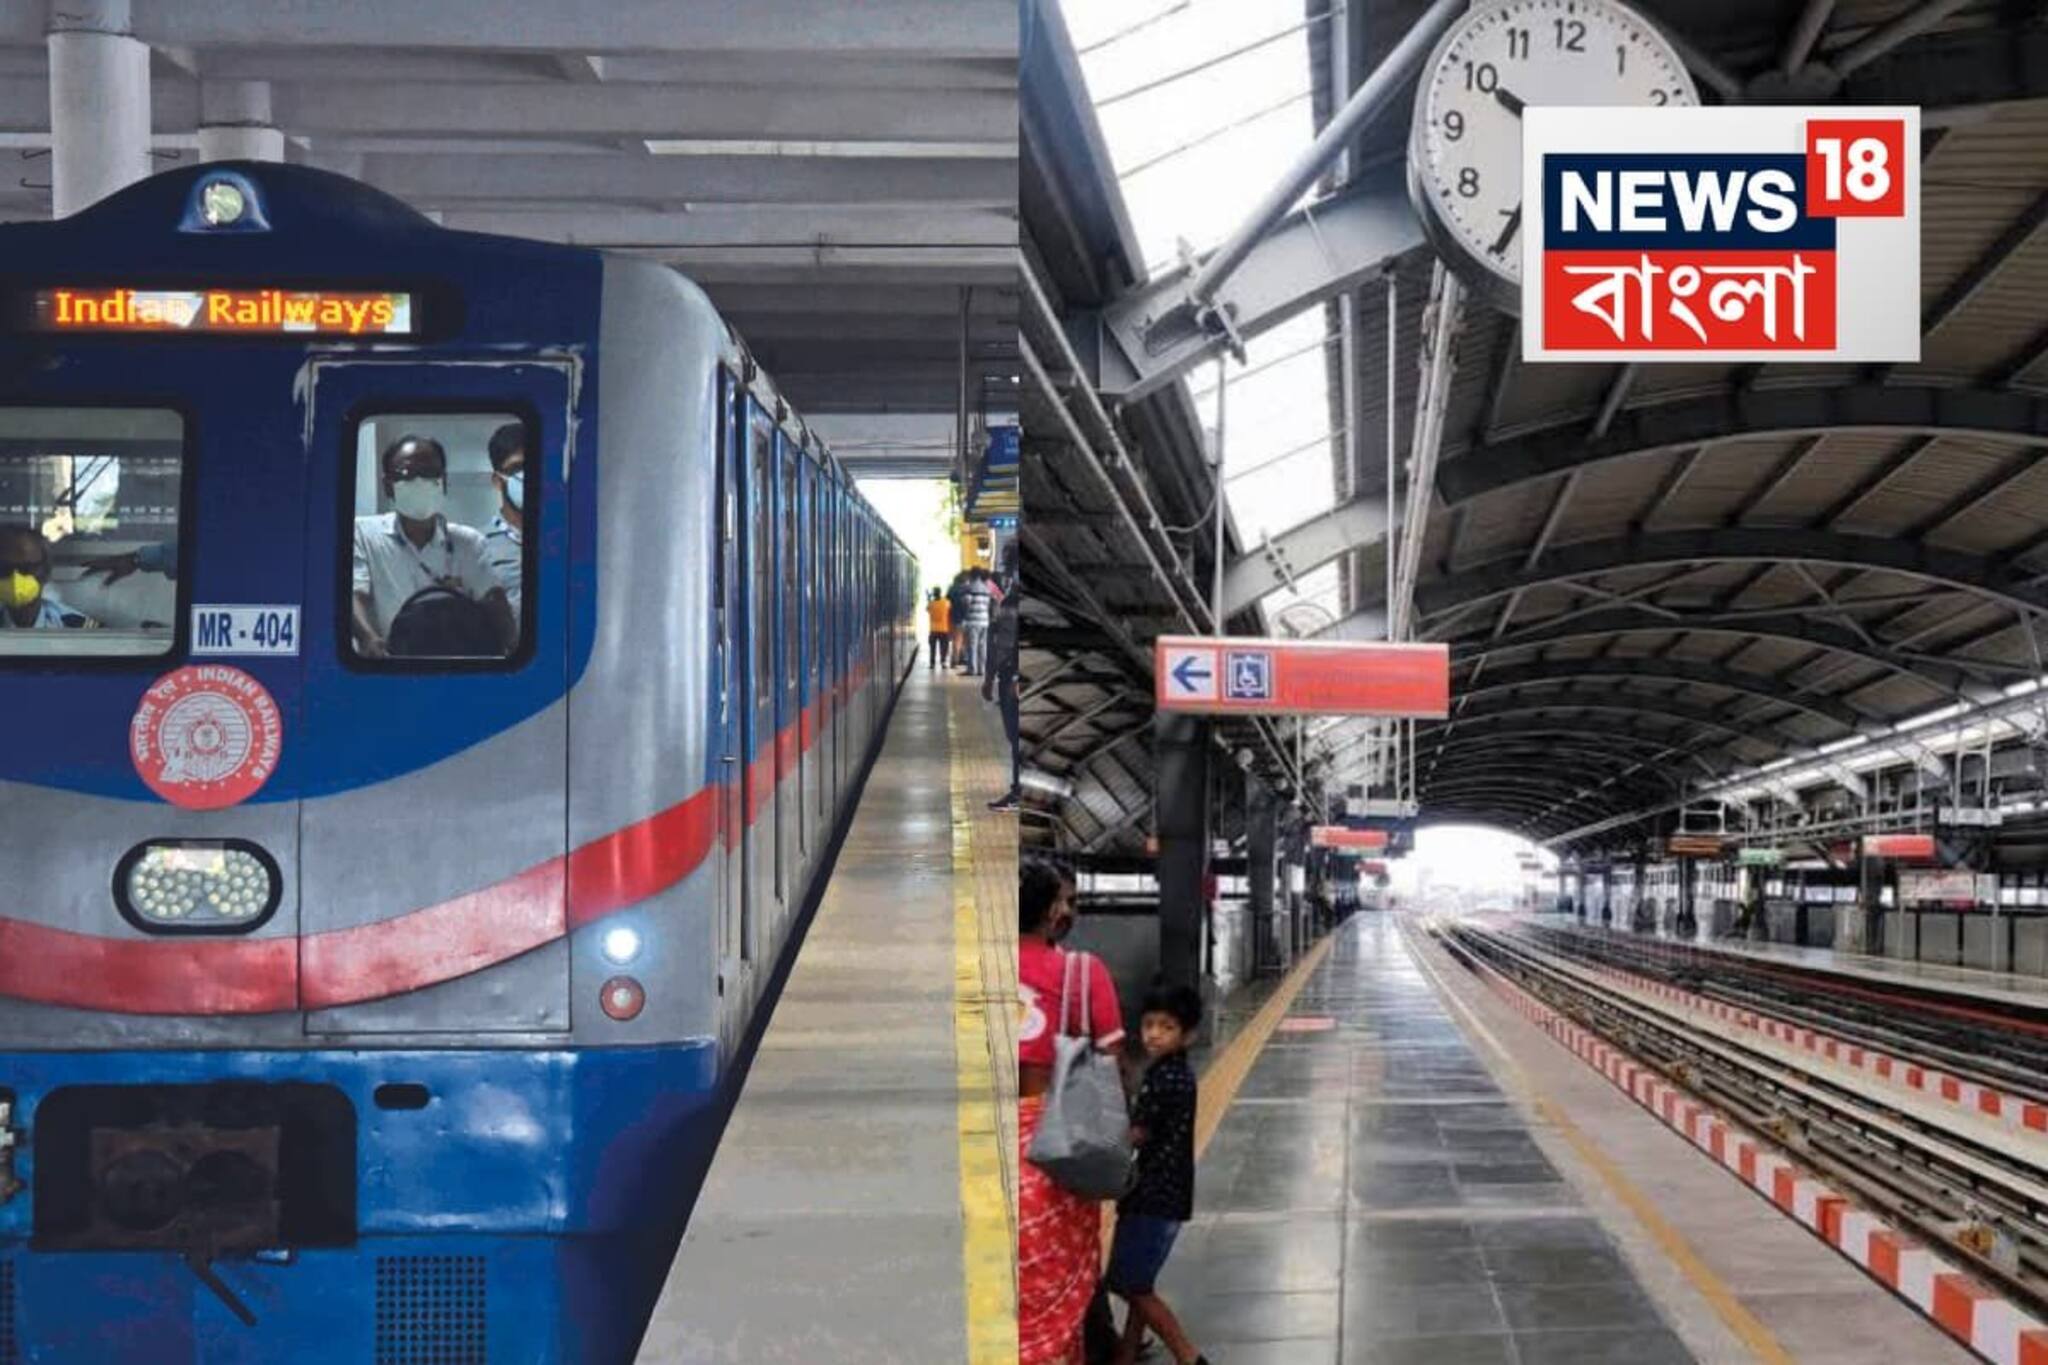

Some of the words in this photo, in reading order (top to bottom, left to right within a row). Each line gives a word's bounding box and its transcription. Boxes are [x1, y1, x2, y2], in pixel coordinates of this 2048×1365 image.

[1507, 27, 1530, 60] 11
[1553, 19, 1586, 52] 12
[1615, 46, 1626, 75] 1
[1464, 62, 1498, 93] 10
[1443, 110, 1464, 140] 9
[1458, 167, 1480, 198] 8
[208, 291, 394, 333] Railways
[198, 612, 233, 648] MR
[253, 612, 294, 648] 404
[198, 667, 258, 695] INDIAN
[251, 695, 280, 779] RAILWAYS
